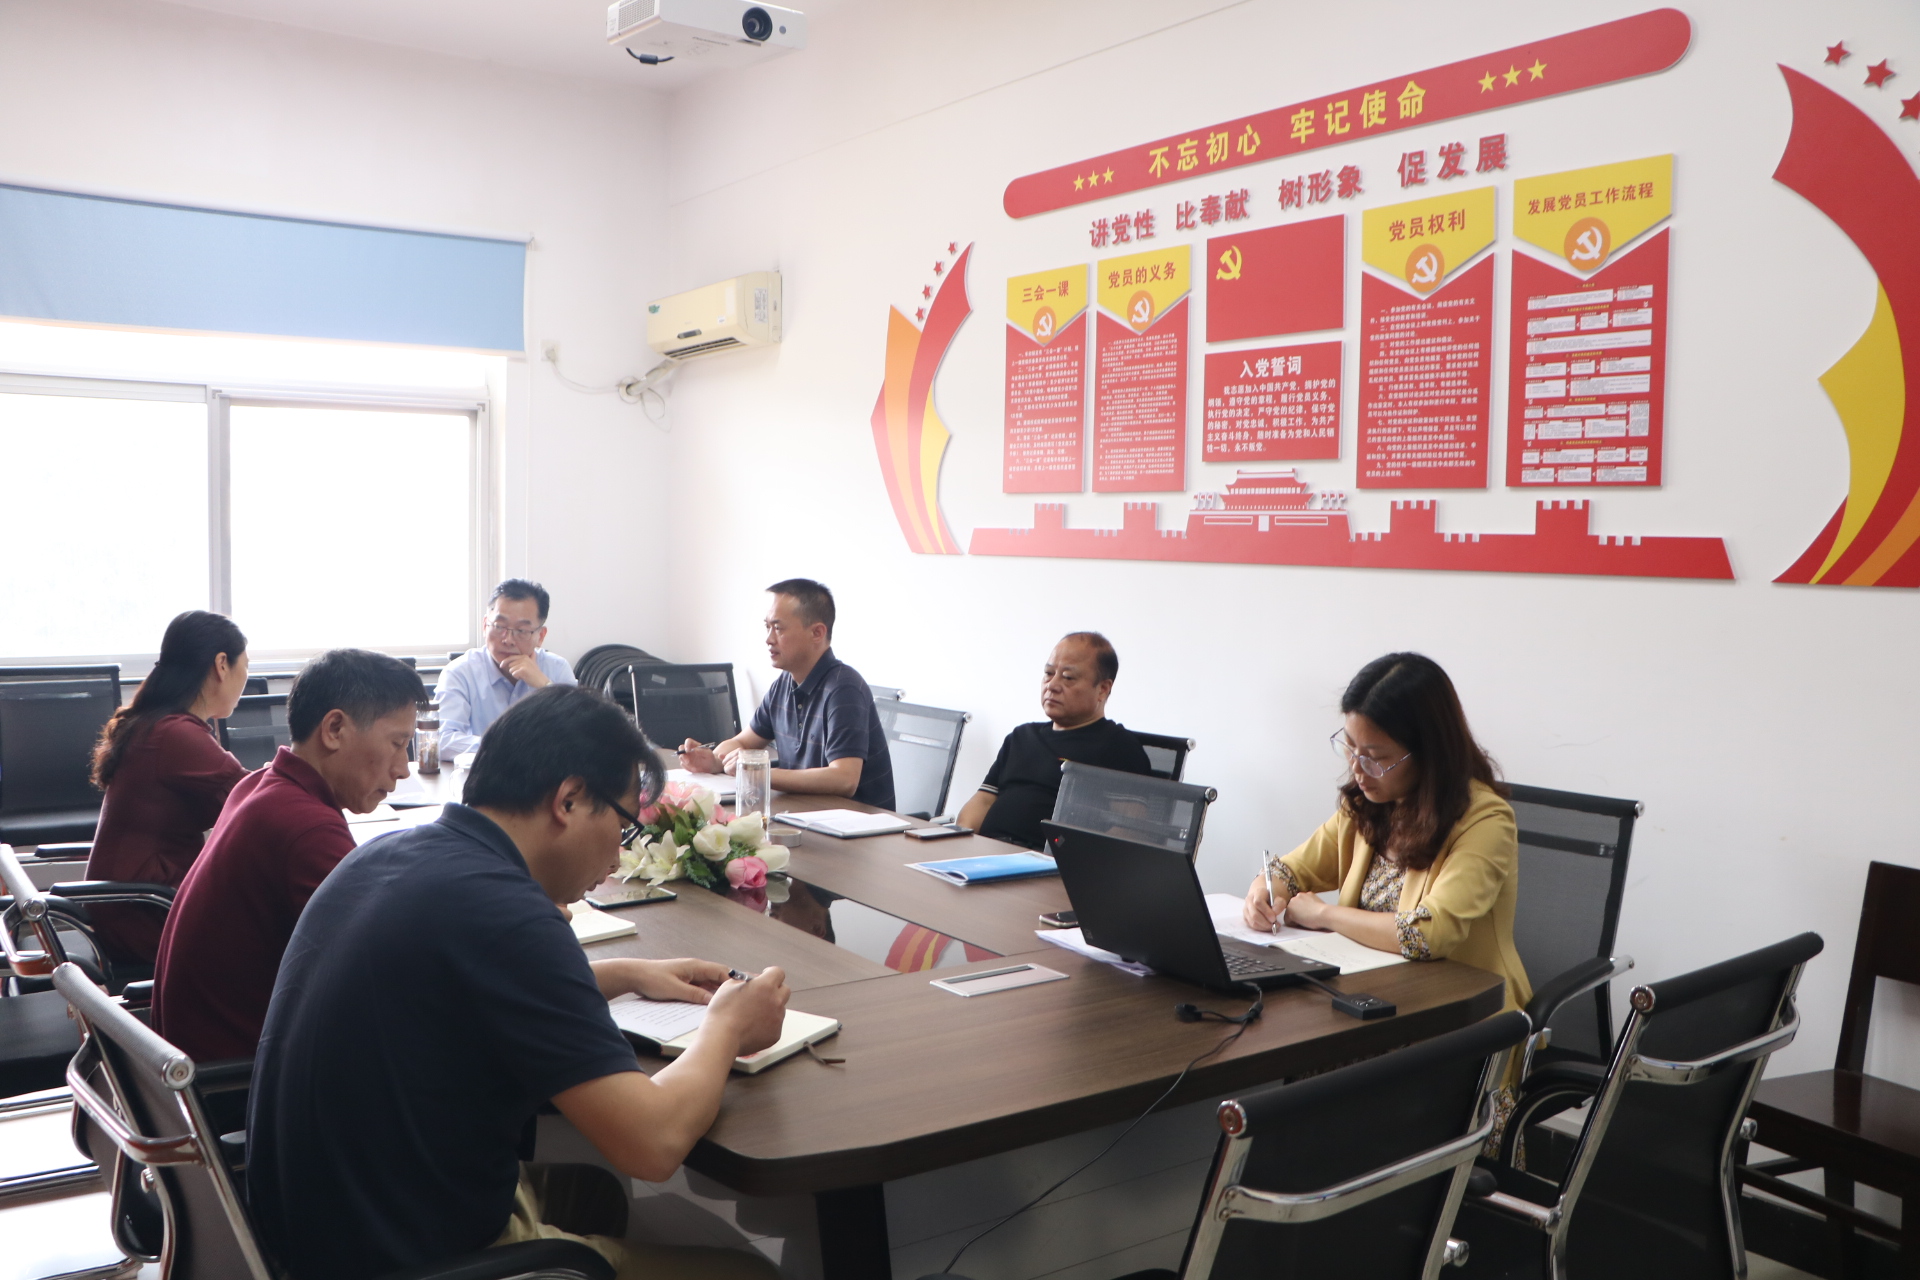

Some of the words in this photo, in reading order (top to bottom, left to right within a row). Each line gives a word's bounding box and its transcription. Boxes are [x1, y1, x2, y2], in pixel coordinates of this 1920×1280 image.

[1149, 125, 1261, 178] 不忘初心
[1290, 81, 1427, 144] 牢记使命
[1089, 210, 1155, 248] 讲党性
[1175, 189, 1250, 230] 比奉献
[1278, 165, 1363, 210] 树形象
[1397, 134, 1508, 188] 促发展
[1527, 181, 1655, 215] 发展党员工作流程
[1389, 210, 1466, 242] 党员权利
[1022, 281, 1070, 302] 三会一课
[1108, 262, 1176, 289] 党员的义务
[1240, 355, 1302, 378] 入党誓词
